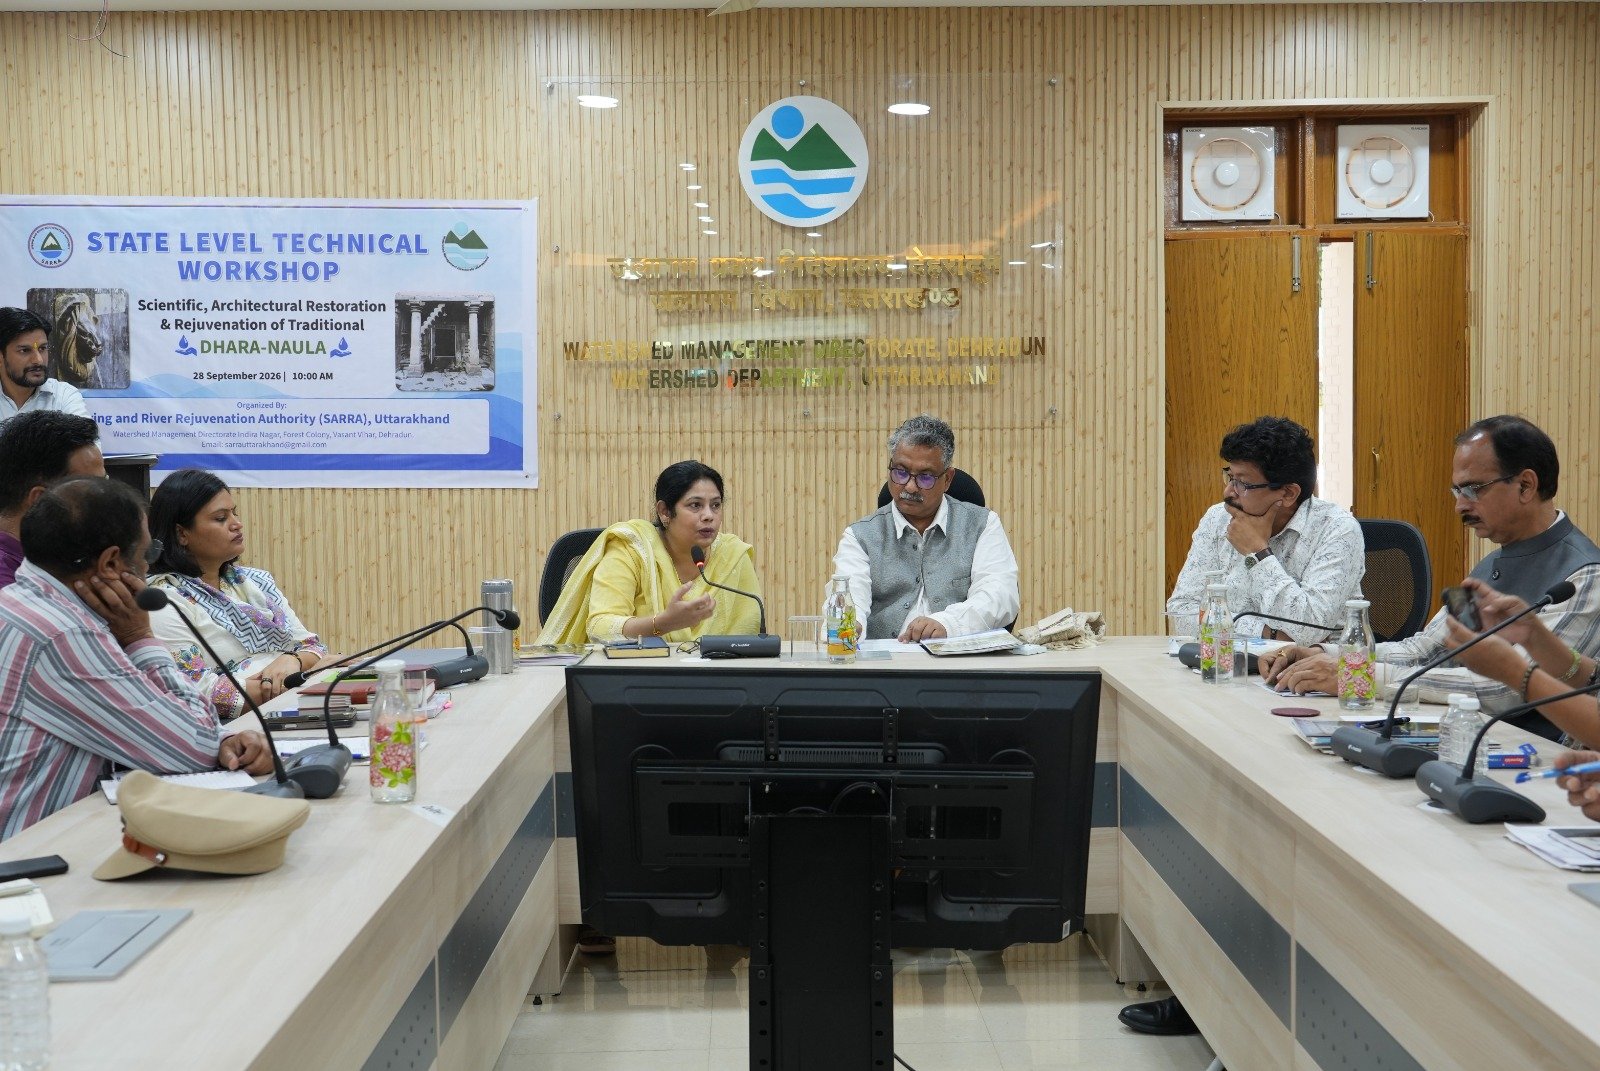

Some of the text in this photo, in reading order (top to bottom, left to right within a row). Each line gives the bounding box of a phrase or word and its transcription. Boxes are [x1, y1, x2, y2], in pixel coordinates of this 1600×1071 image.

[87, 231, 169, 252] STATE
[180, 232, 263, 253] LEVEL
[272, 232, 428, 254] TECHNICAL
[178, 259, 340, 282] WORKSHOP
[138, 299, 386, 313] Scientific, Architectural Restoration
[160, 318, 364, 333] & Rejuvenation of Traditional
[200, 339, 327, 355] DHARA-NAULA
[563, 336, 1046, 362] WATERSHED MANAGEMENT DIRECTORATE, DEHRADUN
[193, 372, 204, 380] 28
[206, 372, 257, 381] September
[259, 372, 281, 380] 2026
[611, 369, 719, 390] WATERSHED
[862, 365, 1000, 387] UTTARAKHAND
[236, 402, 287, 410] Organized By:
[92, 413, 450, 427] ing and River Rejuvenation Authority (SARRA), Uttarakhand
[112, 430, 150, 438] Watershed
[151, 430, 197, 440] Management
[198, 431, 237, 439] Directorate
[259, 431, 281, 440] Nagar,
[305, 431, 332, 440] Colony,
